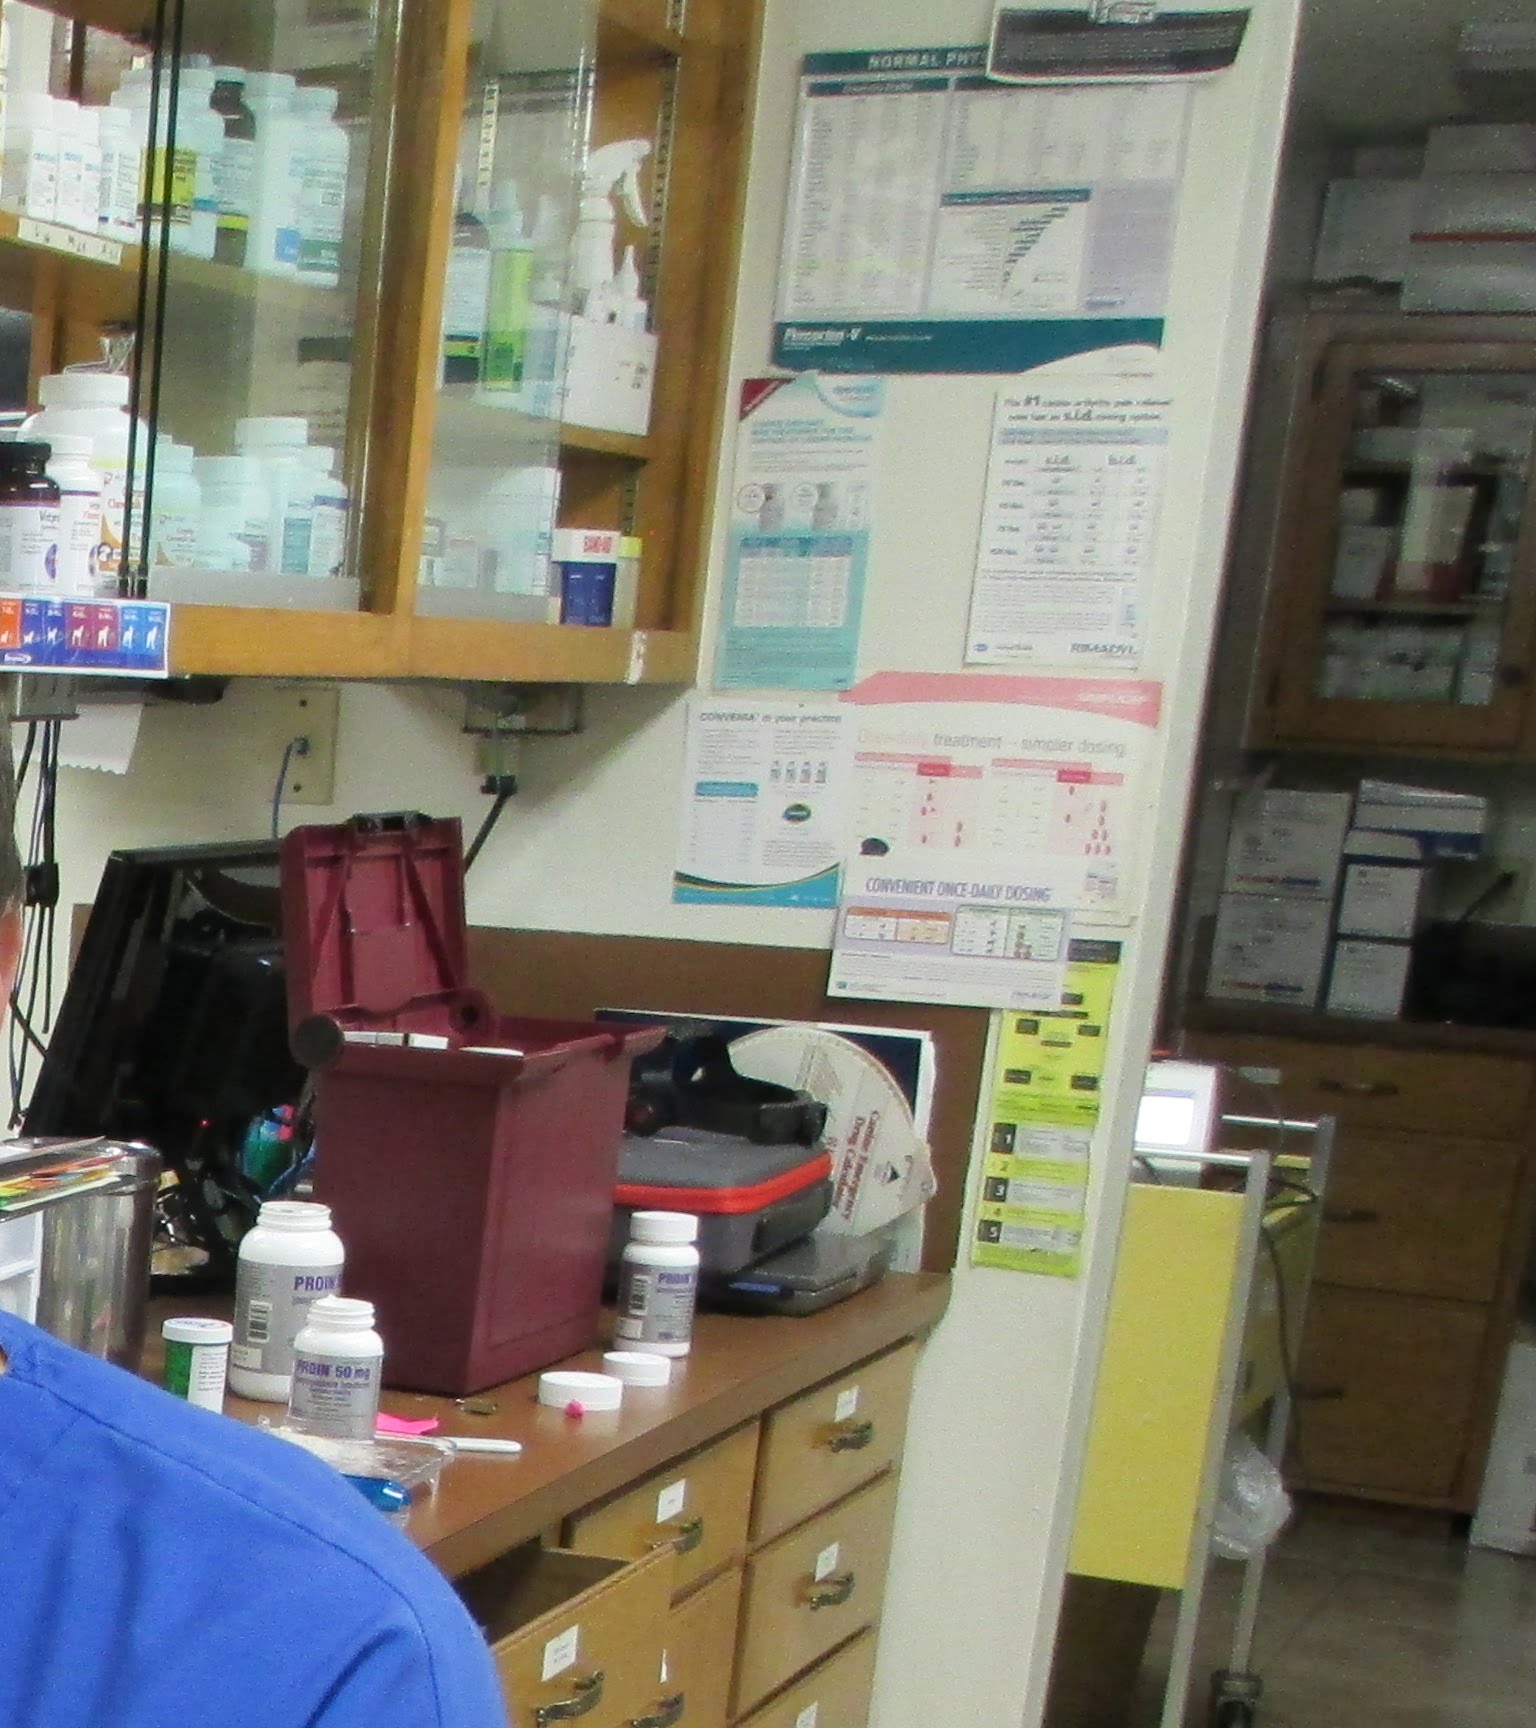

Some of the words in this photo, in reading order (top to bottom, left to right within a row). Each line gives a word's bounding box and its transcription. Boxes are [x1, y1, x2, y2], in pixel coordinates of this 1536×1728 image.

[865, 877, 935, 895] CONVENIENT
[936, 880, 1004, 900] ONCE-DAILY
[1005, 884, 1053, 902] DOSING
[295, 1358, 330, 1379] PROIN
[334, 1365, 353, 1379] 50
